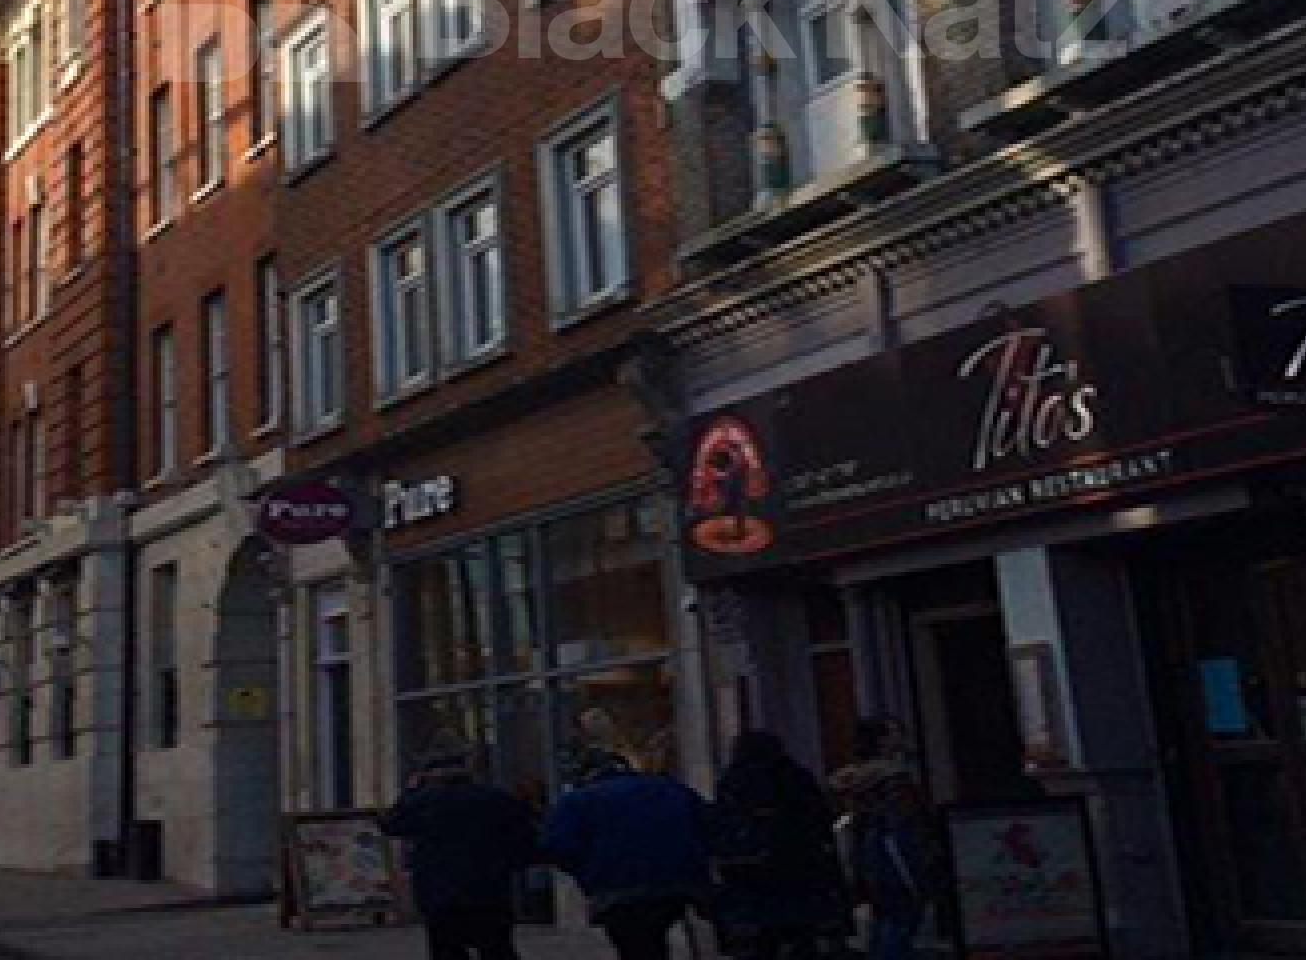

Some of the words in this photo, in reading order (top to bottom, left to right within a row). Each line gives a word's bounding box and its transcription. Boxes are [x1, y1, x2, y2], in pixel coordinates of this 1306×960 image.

[957, 327, 1097, 472] Tito's
[267, 500, 349, 518] Pure
[382, 474, 454, 529] Pure
[925, 485, 1024, 522] PERUVIAN
[1029, 449, 1173, 500] RESTAURANT
